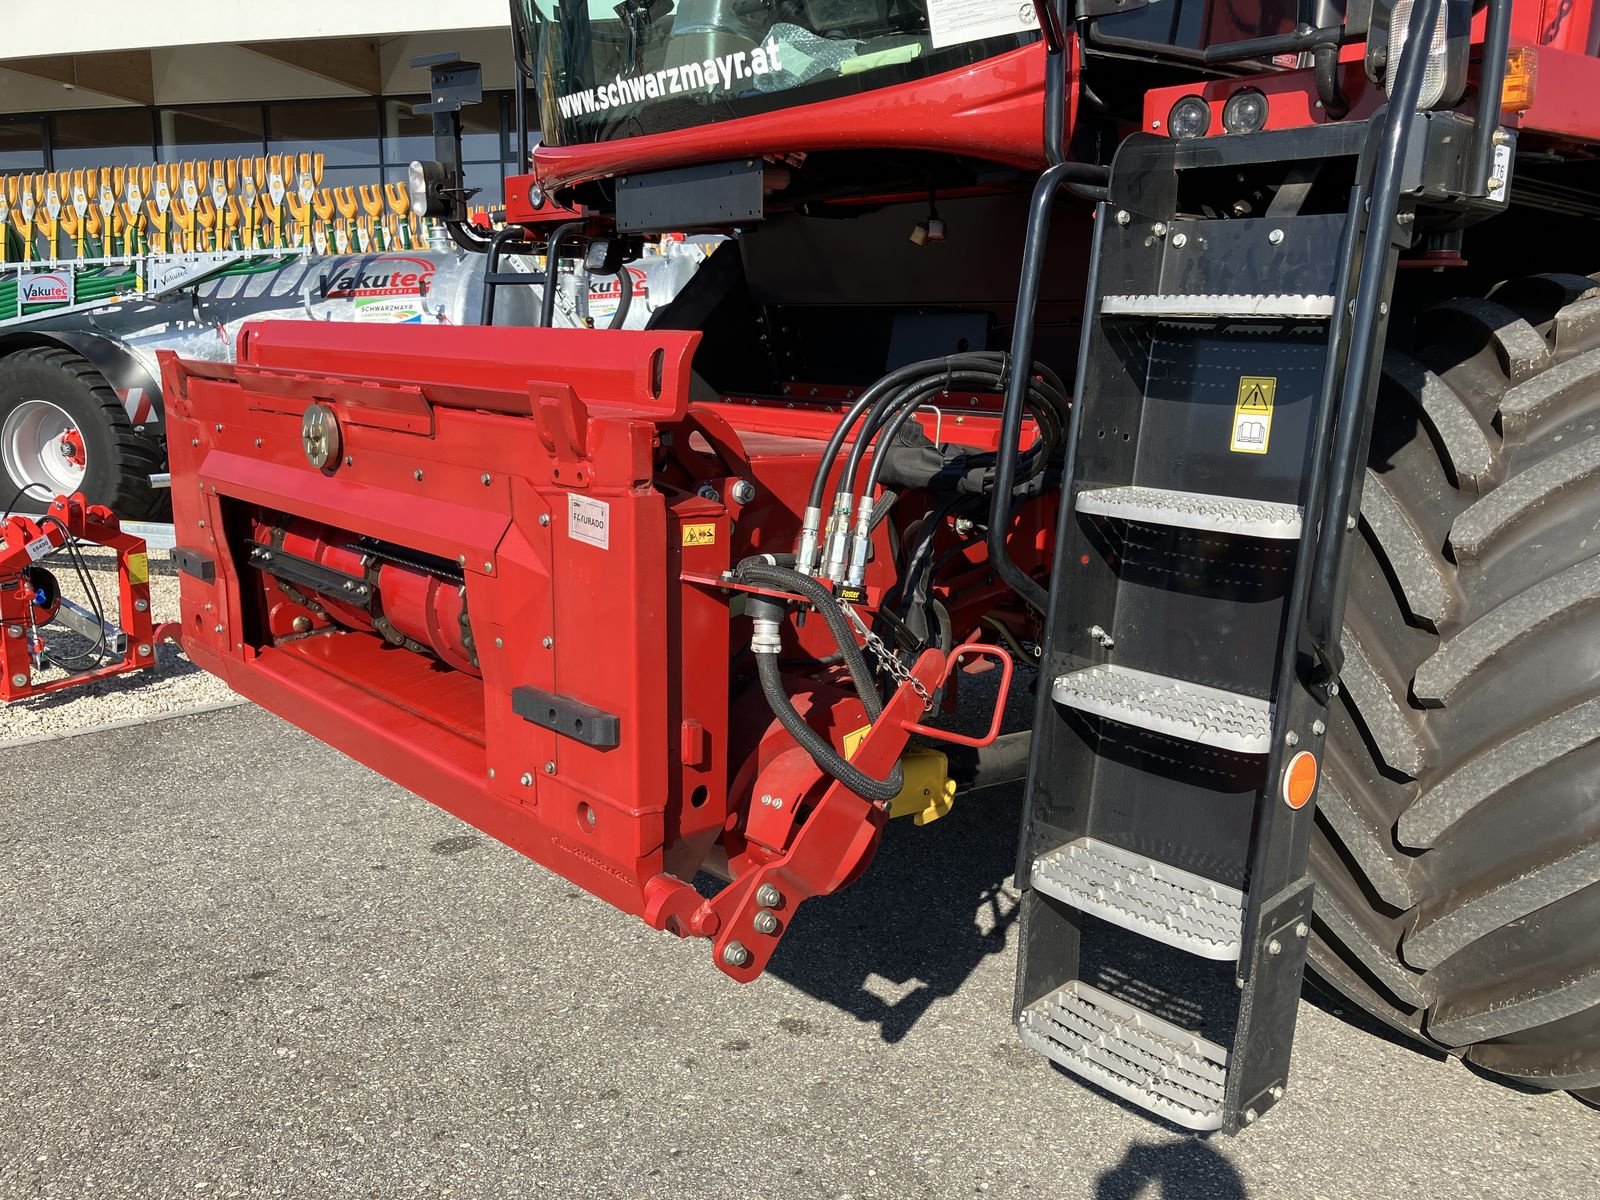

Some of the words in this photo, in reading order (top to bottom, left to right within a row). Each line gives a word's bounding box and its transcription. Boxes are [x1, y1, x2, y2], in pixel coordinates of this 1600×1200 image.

[558, 35, 783, 119] www.schwarzmayr.at
[22, 283, 68, 301] Vakutec
[319, 268, 434, 298] Vakutec
[588, 279, 647, 294] kutc
[361, 304, 414, 313] SCHWARZMAYR
